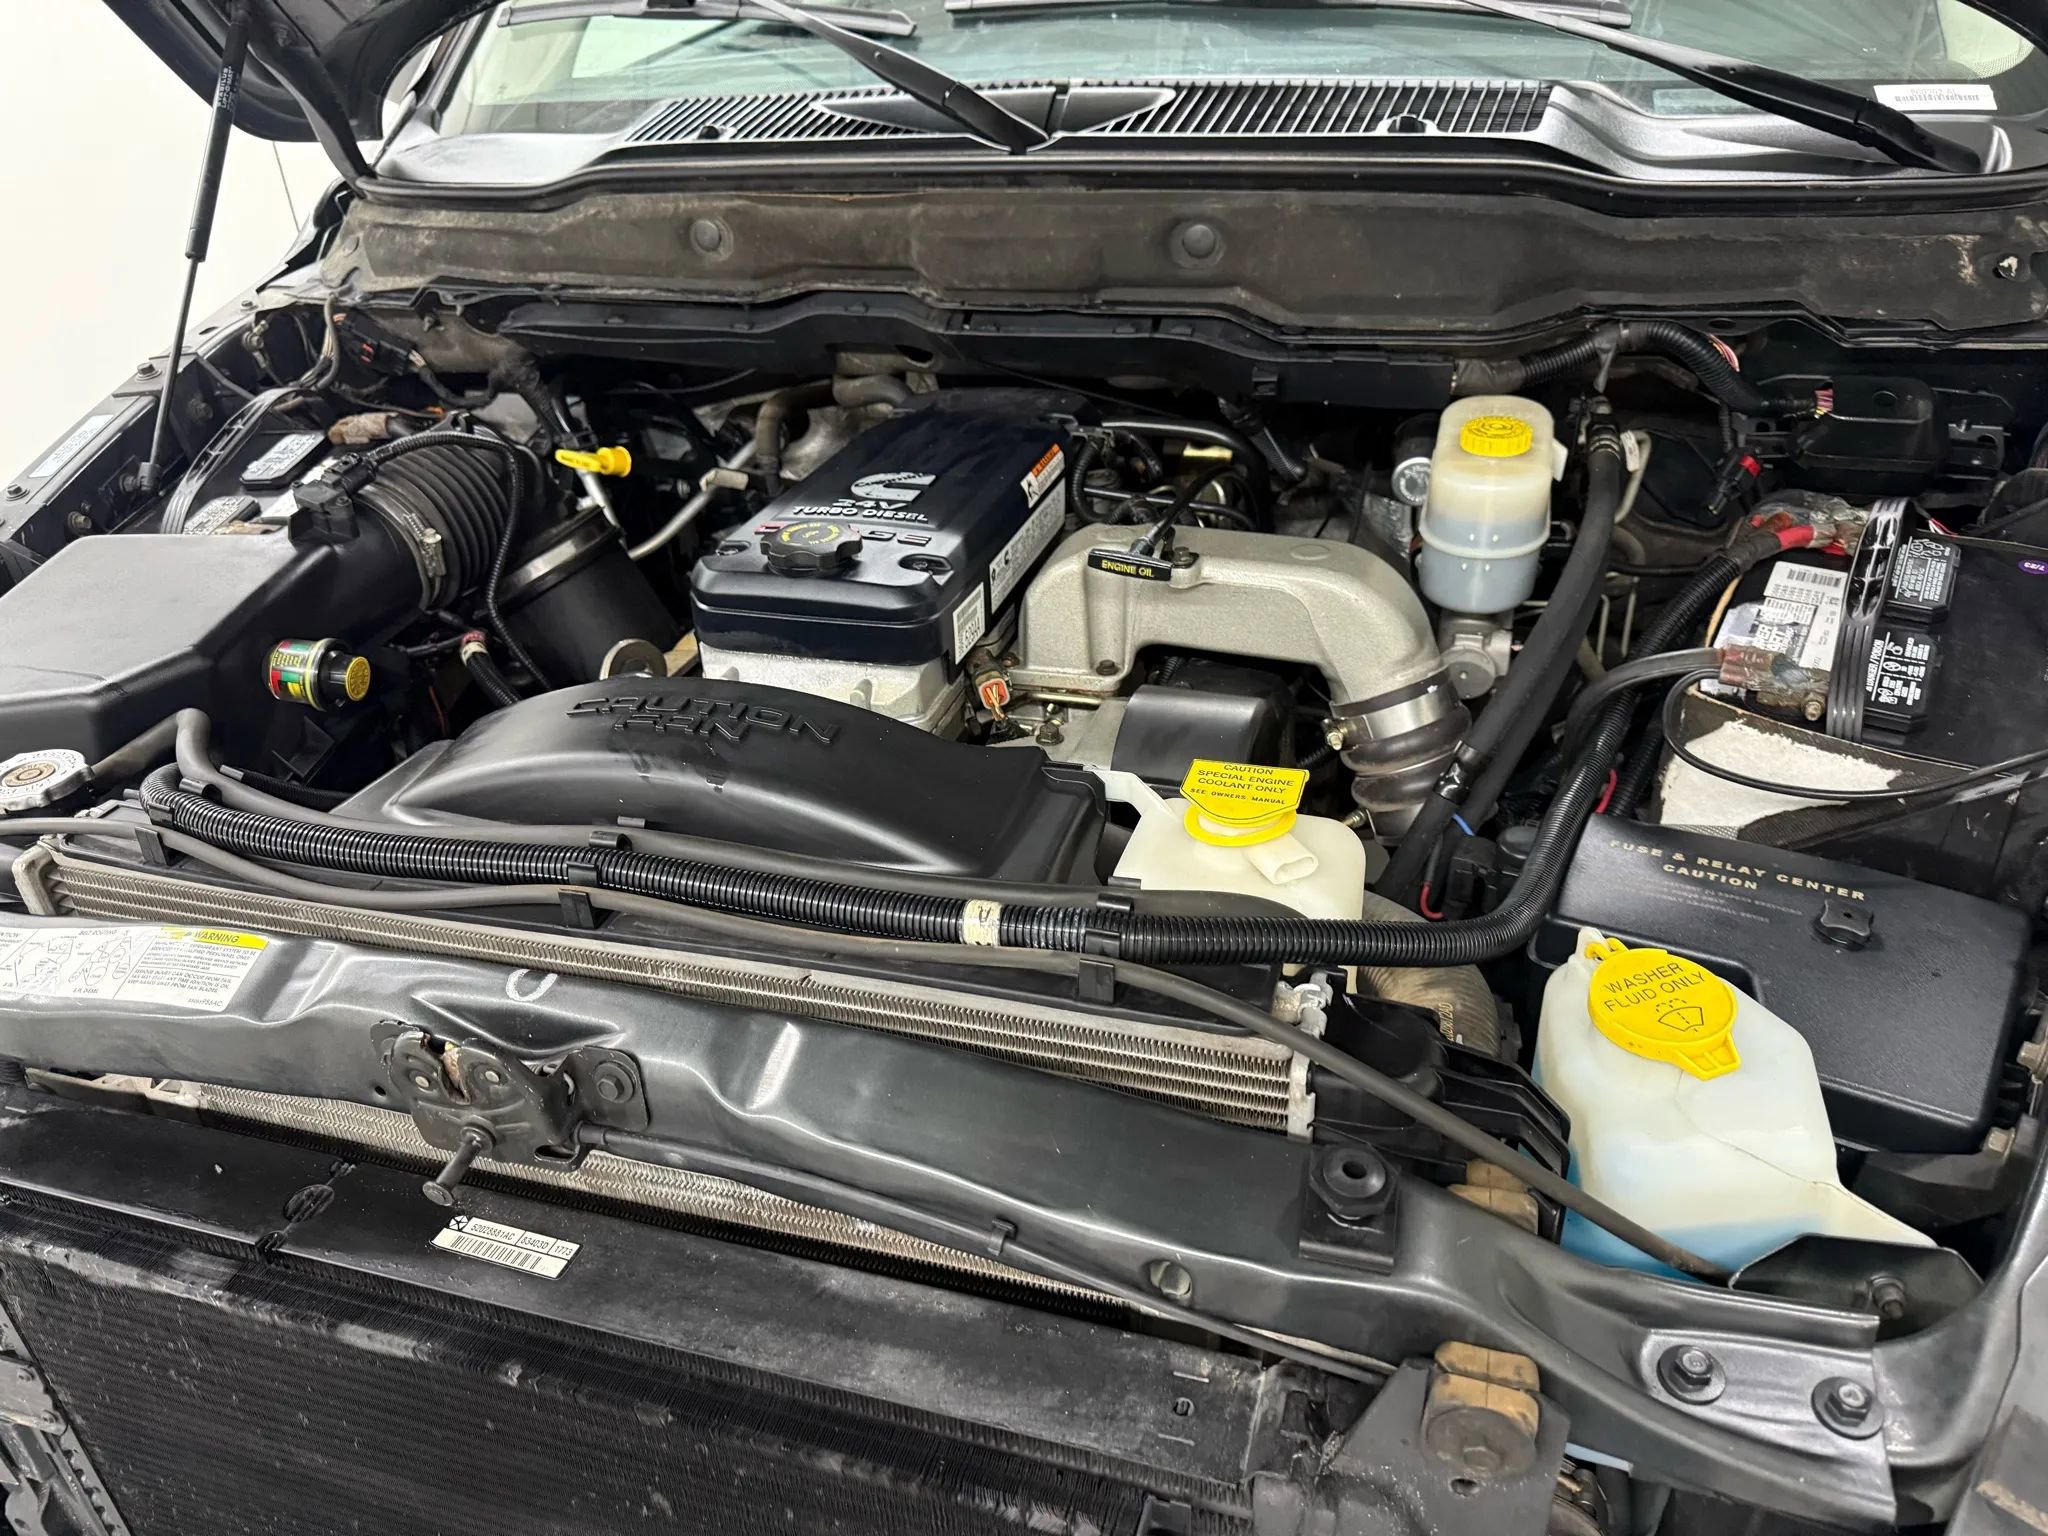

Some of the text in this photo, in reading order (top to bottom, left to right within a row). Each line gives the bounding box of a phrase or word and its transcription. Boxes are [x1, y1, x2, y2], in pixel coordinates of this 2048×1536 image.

[832, 498, 908, 511] 24V
[793, 505, 929, 523] TURBO DIESEL
[754, 522, 933, 547] DGE
[1101, 560, 1154, 578] ENGINE OIL
[566, 696, 840, 744] CAUTION
[1198, 769, 1295, 787] SPECIAL ENGINE
[1223, 764, 1274, 775] CAUTION
[1197, 778, 1286, 794] COOLANT ONLY
[1190, 787, 1286, 805] SEE OWNERS MANUAL
[1610, 840, 1866, 901] FUSE & RELAY CENTER
[1662, 864, 1759, 890] CAUTION
[194, 930, 240, 944] WARNING
[1604, 962, 1684, 994] WASHER
[1604, 971, 1705, 1012] FLUID ONLY
[554, 1245, 573, 1256] 1773
